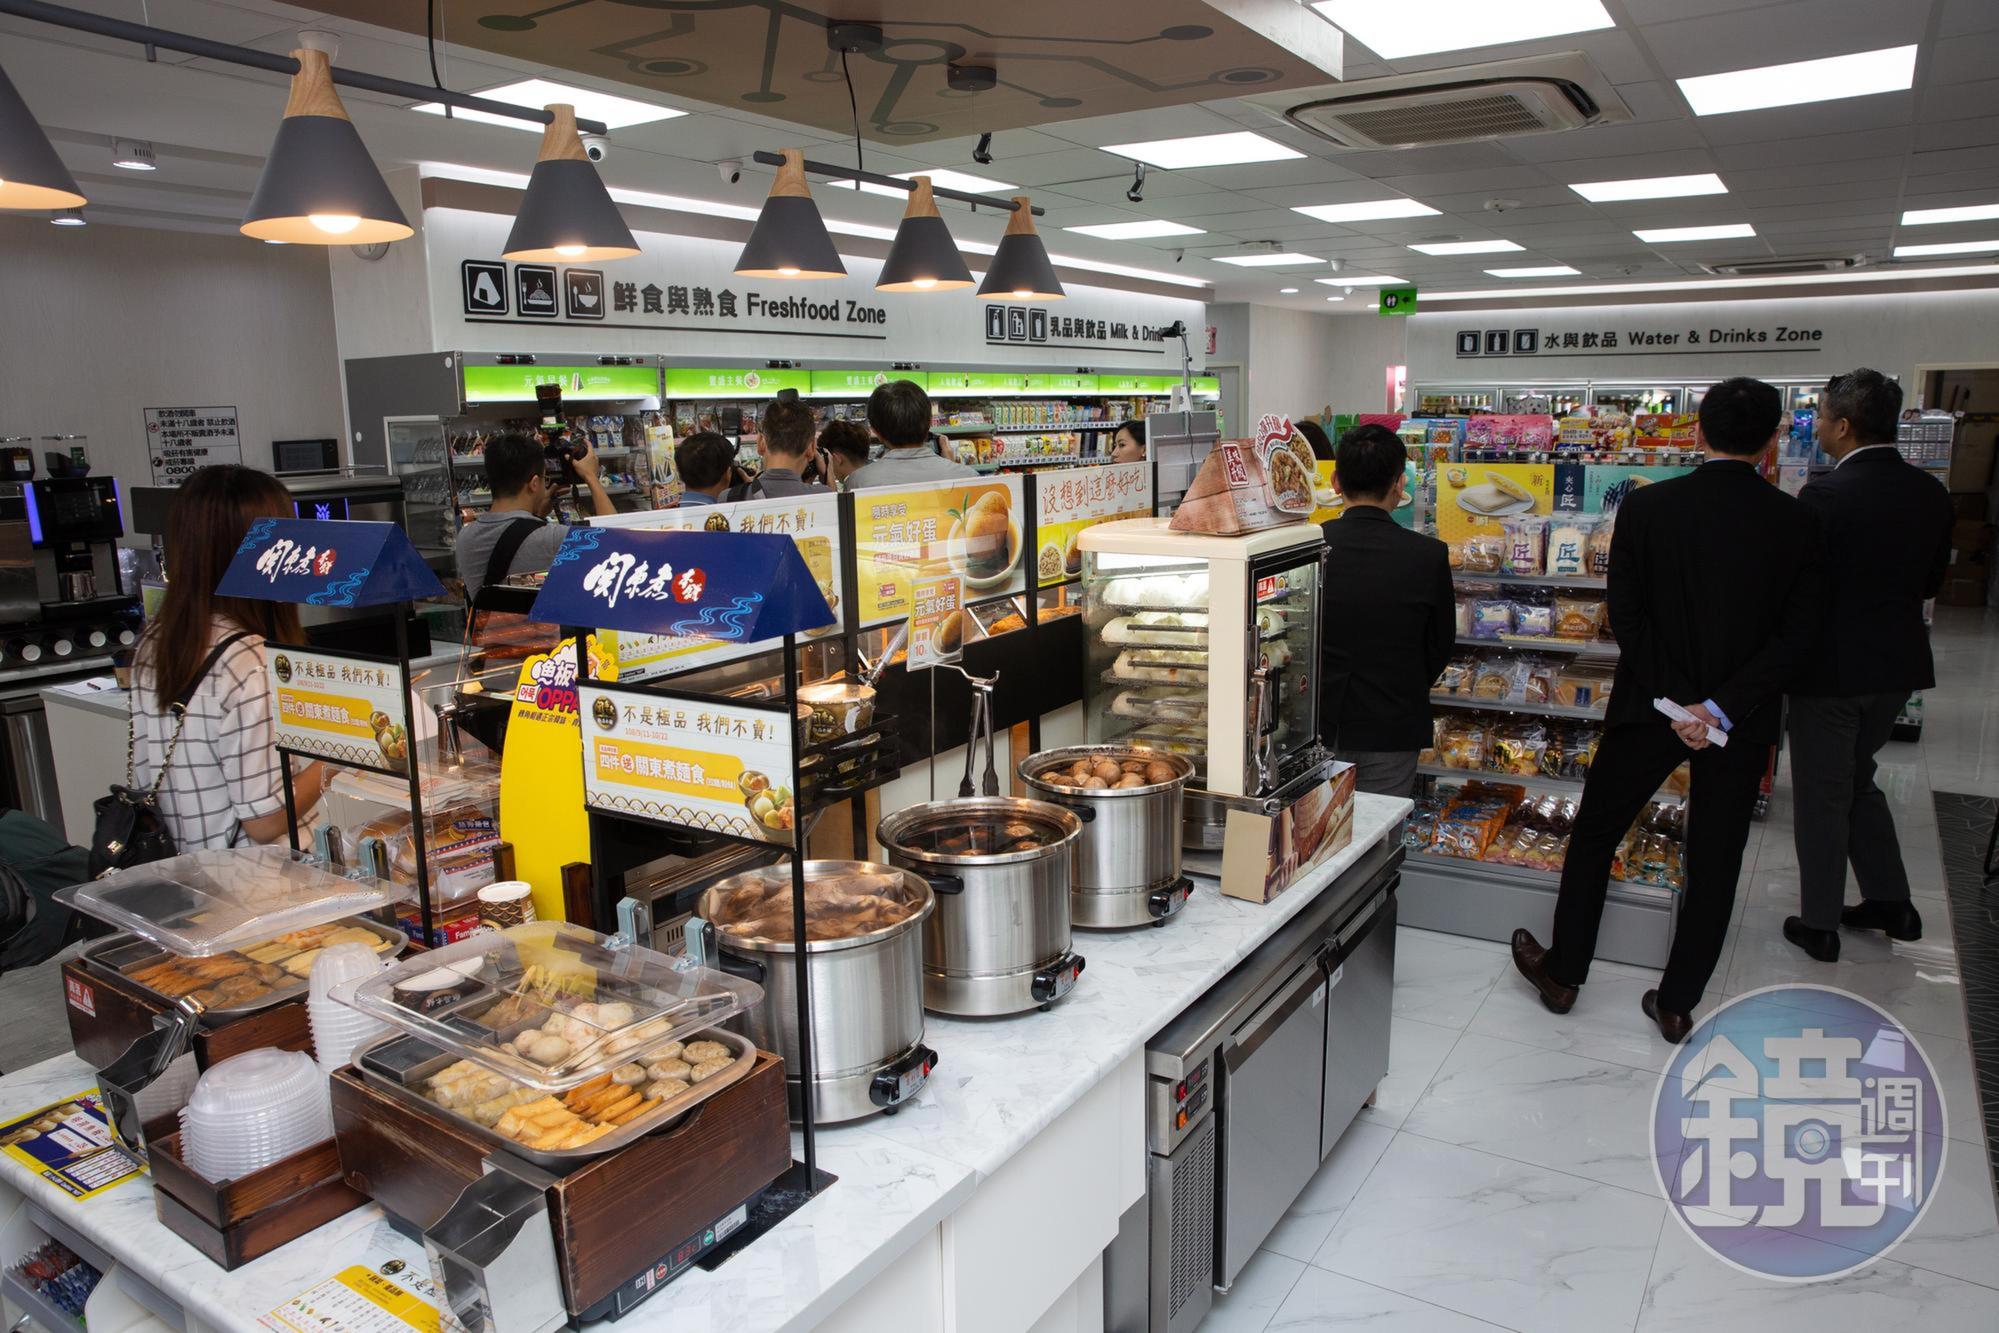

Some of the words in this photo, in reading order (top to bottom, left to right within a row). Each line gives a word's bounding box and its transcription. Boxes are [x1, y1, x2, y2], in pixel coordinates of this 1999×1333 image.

[613, 281, 738, 317] 鮮食與熟食
[747, 292, 839, 322] Freshfood
[847, 300, 887, 324] Zone
[1050, 317, 1107, 341] 乳品與飲品
[1110, 322, 1128, 340] Milk
[1131, 326, 1139, 341] &
[1544, 331, 1618, 350] 水與飲品
[1628, 330, 1680, 346] Water
[1688, 329, 1701, 345] &
[1709, 328, 1767, 344] Drinks
[1776, 326, 1823, 342] Zone
[1043, 466, 1147, 514] 沒想到這麼好吃!
[873, 518, 937, 544] 元氣好蛋
[623, 704, 688, 729] 不是極品
[696, 712, 775, 741] 我們不賣!
